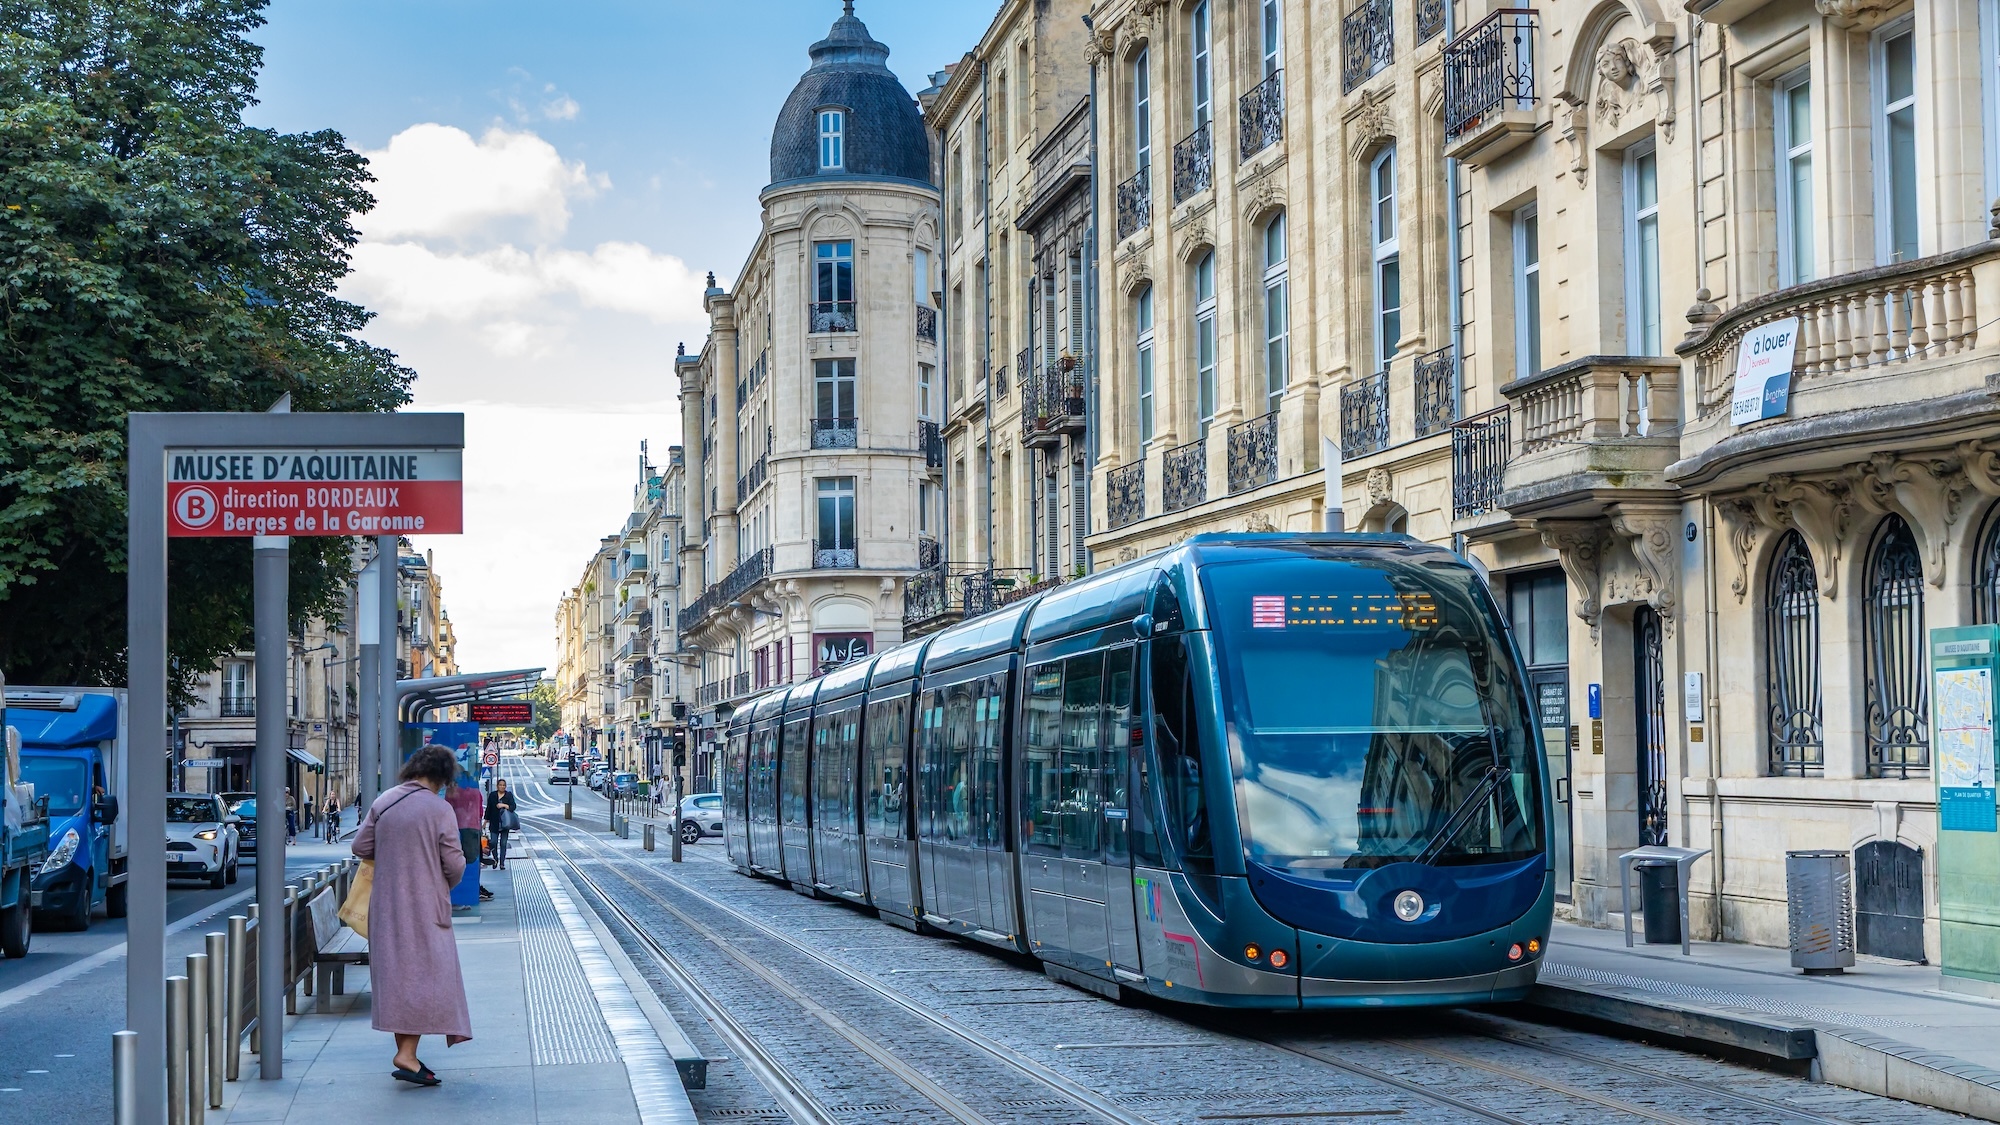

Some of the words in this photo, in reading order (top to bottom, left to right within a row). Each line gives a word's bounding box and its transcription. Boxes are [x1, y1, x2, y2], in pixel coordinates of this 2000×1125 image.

[1754, 336, 1761, 355] à
[173, 455, 253, 480] MUSEE
[263, 455, 418, 480] D'AQUITAINE
[187, 495, 206, 520] B
[223, 487, 299, 508] direction
[306, 487, 399, 508] BORDEAUX
[223, 511, 287, 536] Berges
[294, 510, 316, 531] de
[323, 510, 340, 531] la
[347, 510, 425, 531] Garonne
[1542, 688, 1557, 696] CABINET
[1557, 688, 1563, 696] DE
